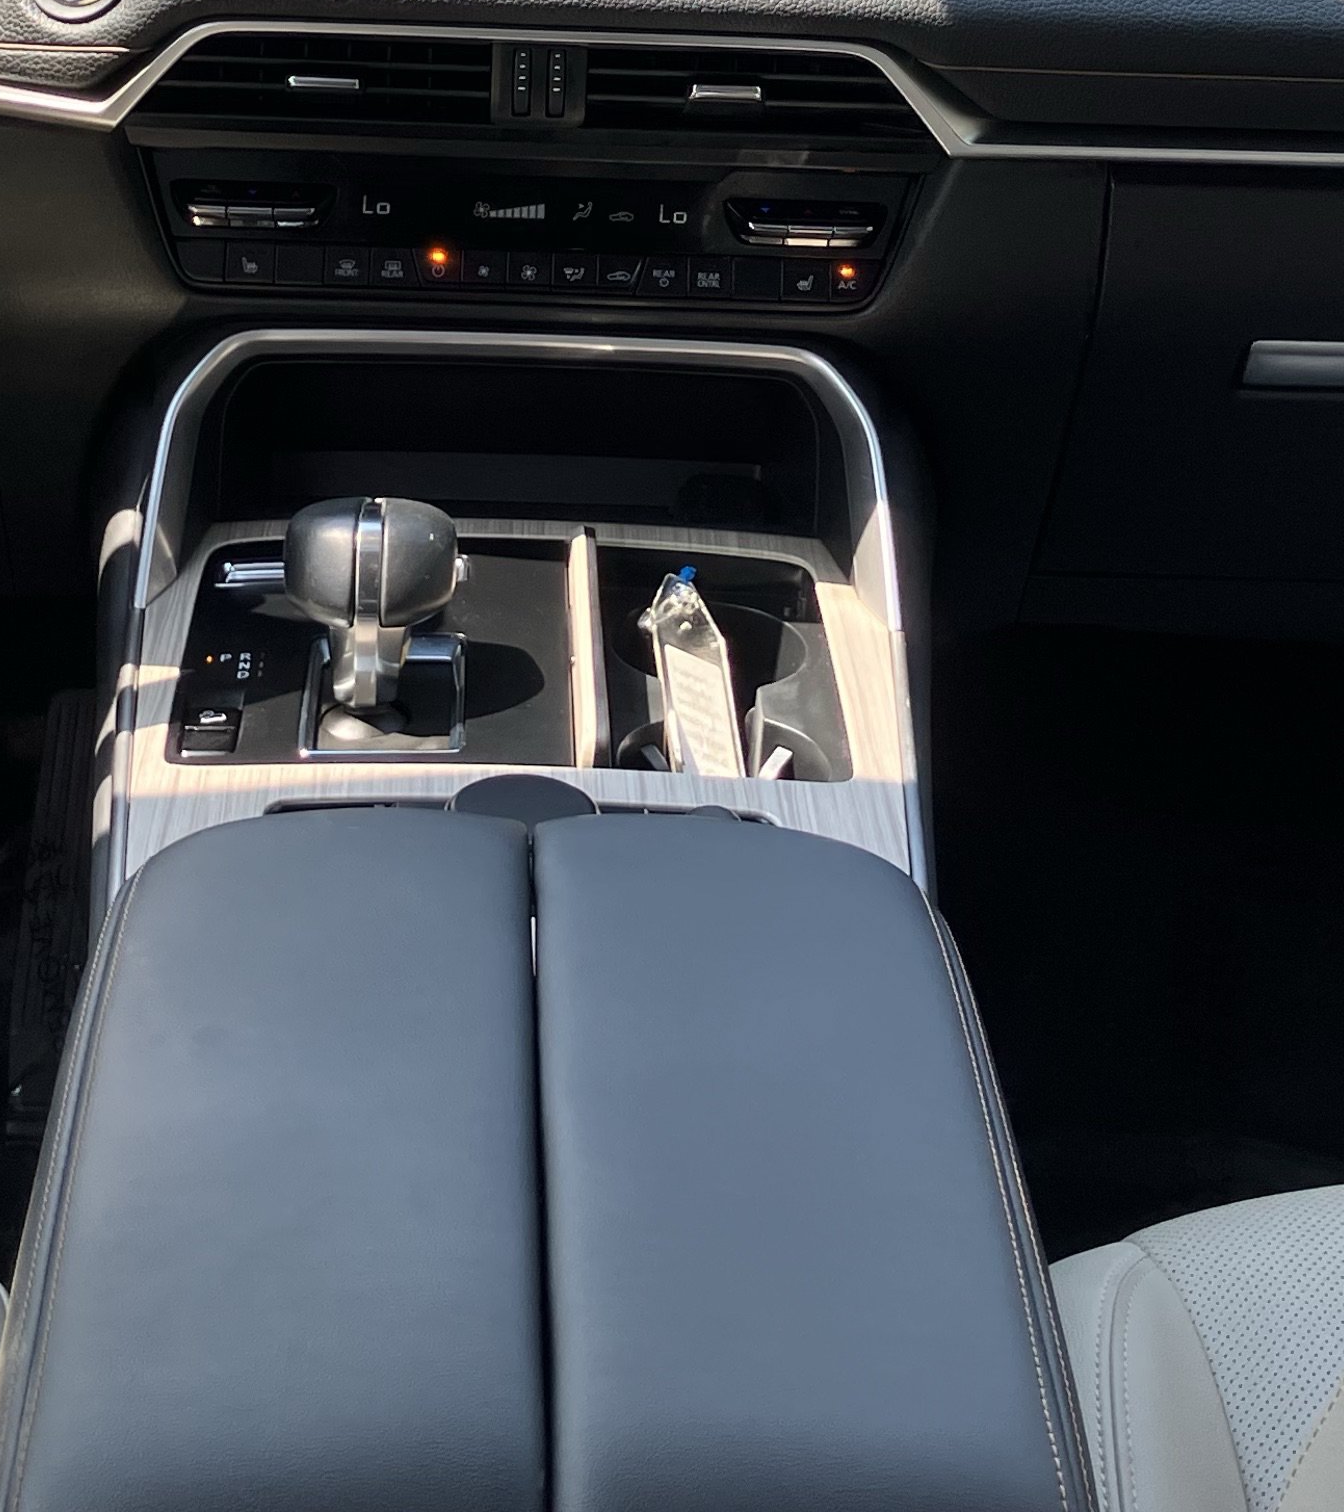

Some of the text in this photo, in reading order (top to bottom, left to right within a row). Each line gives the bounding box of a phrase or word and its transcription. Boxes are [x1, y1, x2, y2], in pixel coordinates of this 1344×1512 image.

[362, 194, 391, 215] Lo
[659, 204, 687, 224] Lo
[219, 653, 232, 663] P
[240, 652, 251, 661] R
[238, 661, 251, 670] N
[237, 670, 250, 679] D
